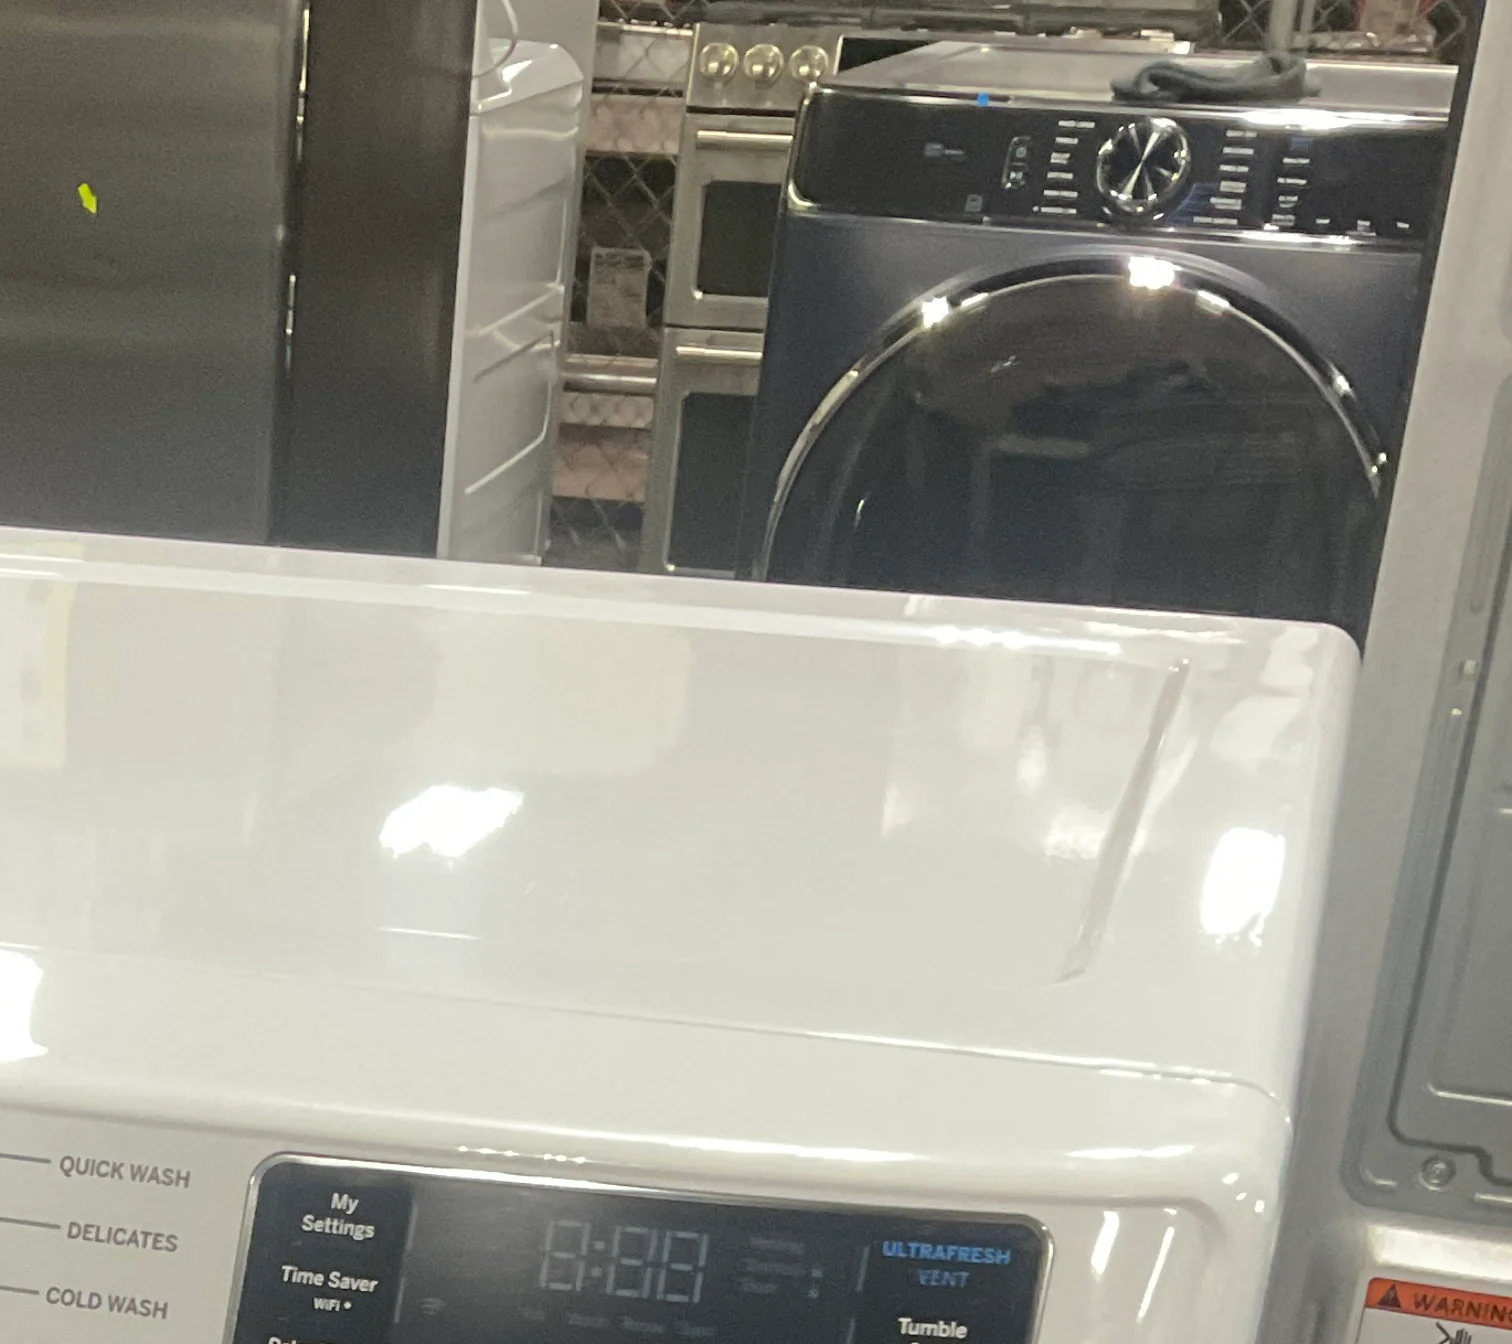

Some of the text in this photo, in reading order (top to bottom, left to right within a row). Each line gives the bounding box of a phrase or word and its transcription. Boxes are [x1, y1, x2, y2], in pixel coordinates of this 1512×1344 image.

[59, 1155, 191, 1189] QUICK WASH
[330, 1191, 360, 1215] My
[66, 1220, 180, 1253] DELICATES
[301, 1213, 376, 1242] Settings
[881, 1239, 1012, 1265] ULTRAFRESH
[280, 1264, 379, 1293] Time Saver
[917, 1268, 971, 1289] VENT
[45, 1286, 169, 1320] COLD WASH
[313, 1297, 341, 1312] WiFi
[897, 1316, 969, 1340] Tumble
